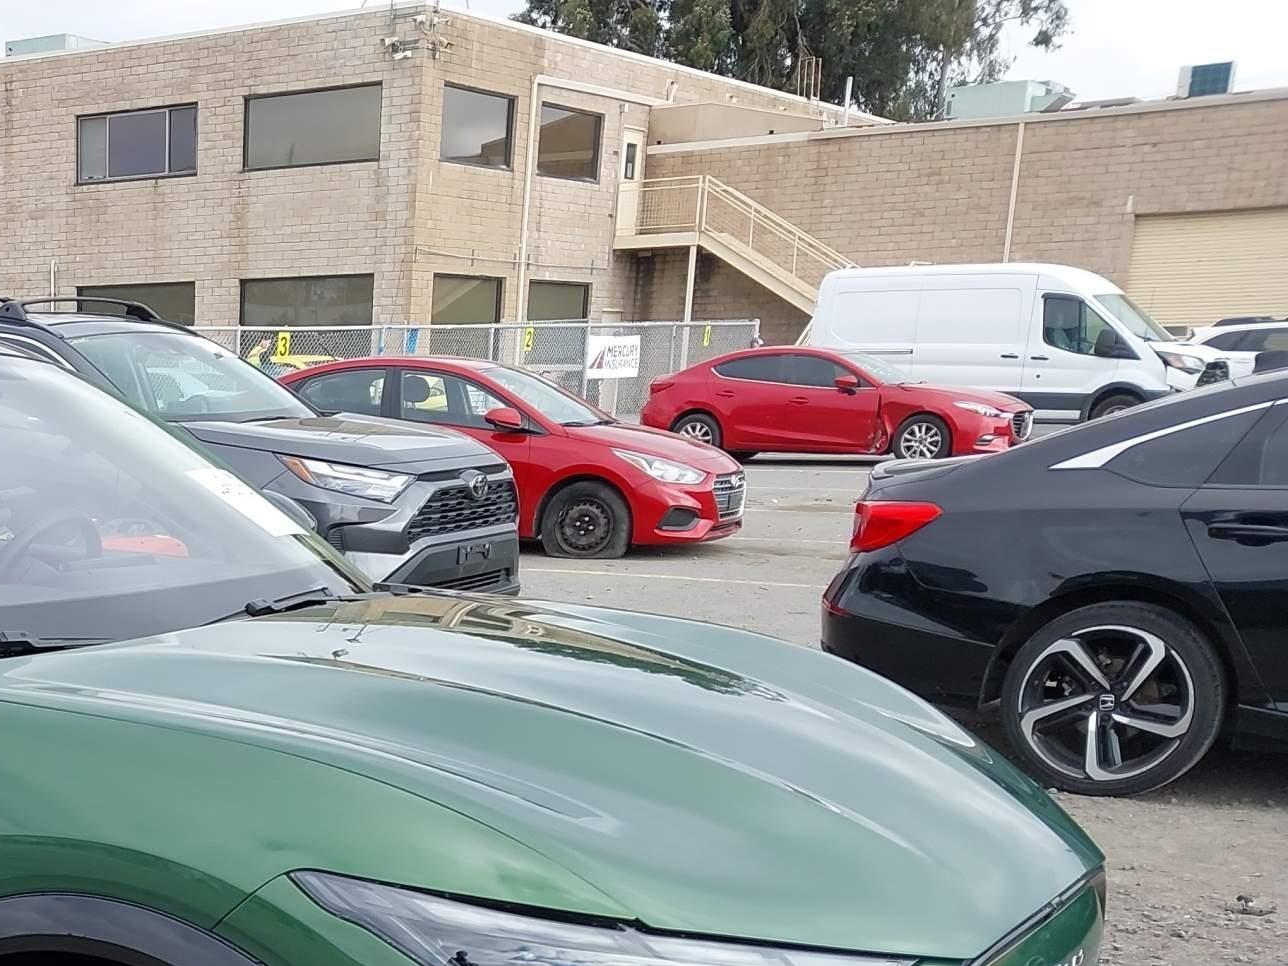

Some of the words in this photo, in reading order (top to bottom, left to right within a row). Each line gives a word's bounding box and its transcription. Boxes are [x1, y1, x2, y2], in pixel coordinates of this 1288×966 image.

[280, 336, 288, 356] 3
[526, 330, 532, 347] 2
[606, 344, 639, 357] MERCURY
